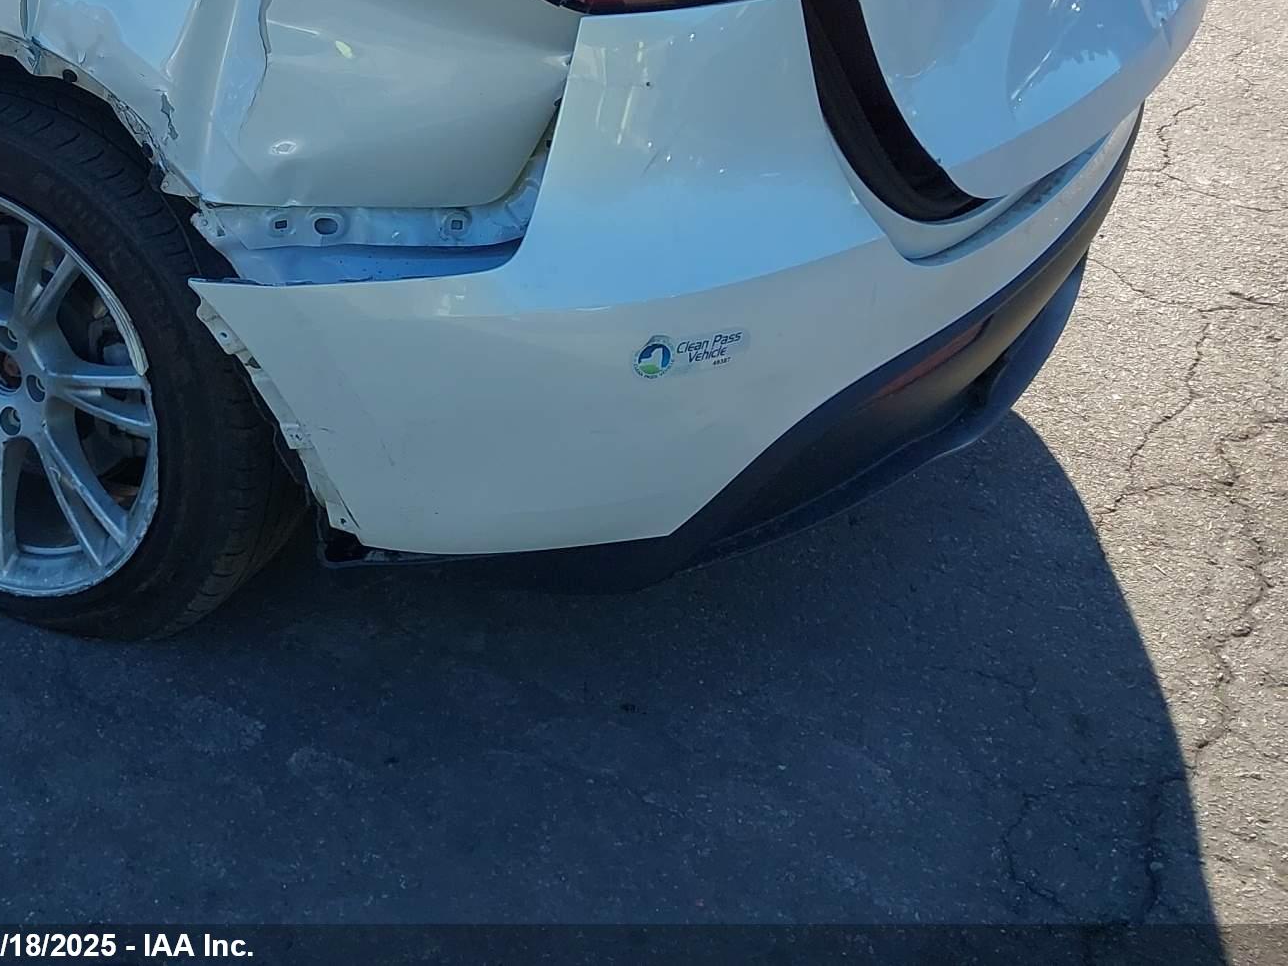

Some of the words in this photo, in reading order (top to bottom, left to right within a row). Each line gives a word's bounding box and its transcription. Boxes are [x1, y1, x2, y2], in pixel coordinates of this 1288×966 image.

[676, 339, 710, 354] Clean
[712, 331, 742, 347] Pass
[688, 346, 727, 363] Vehicle
